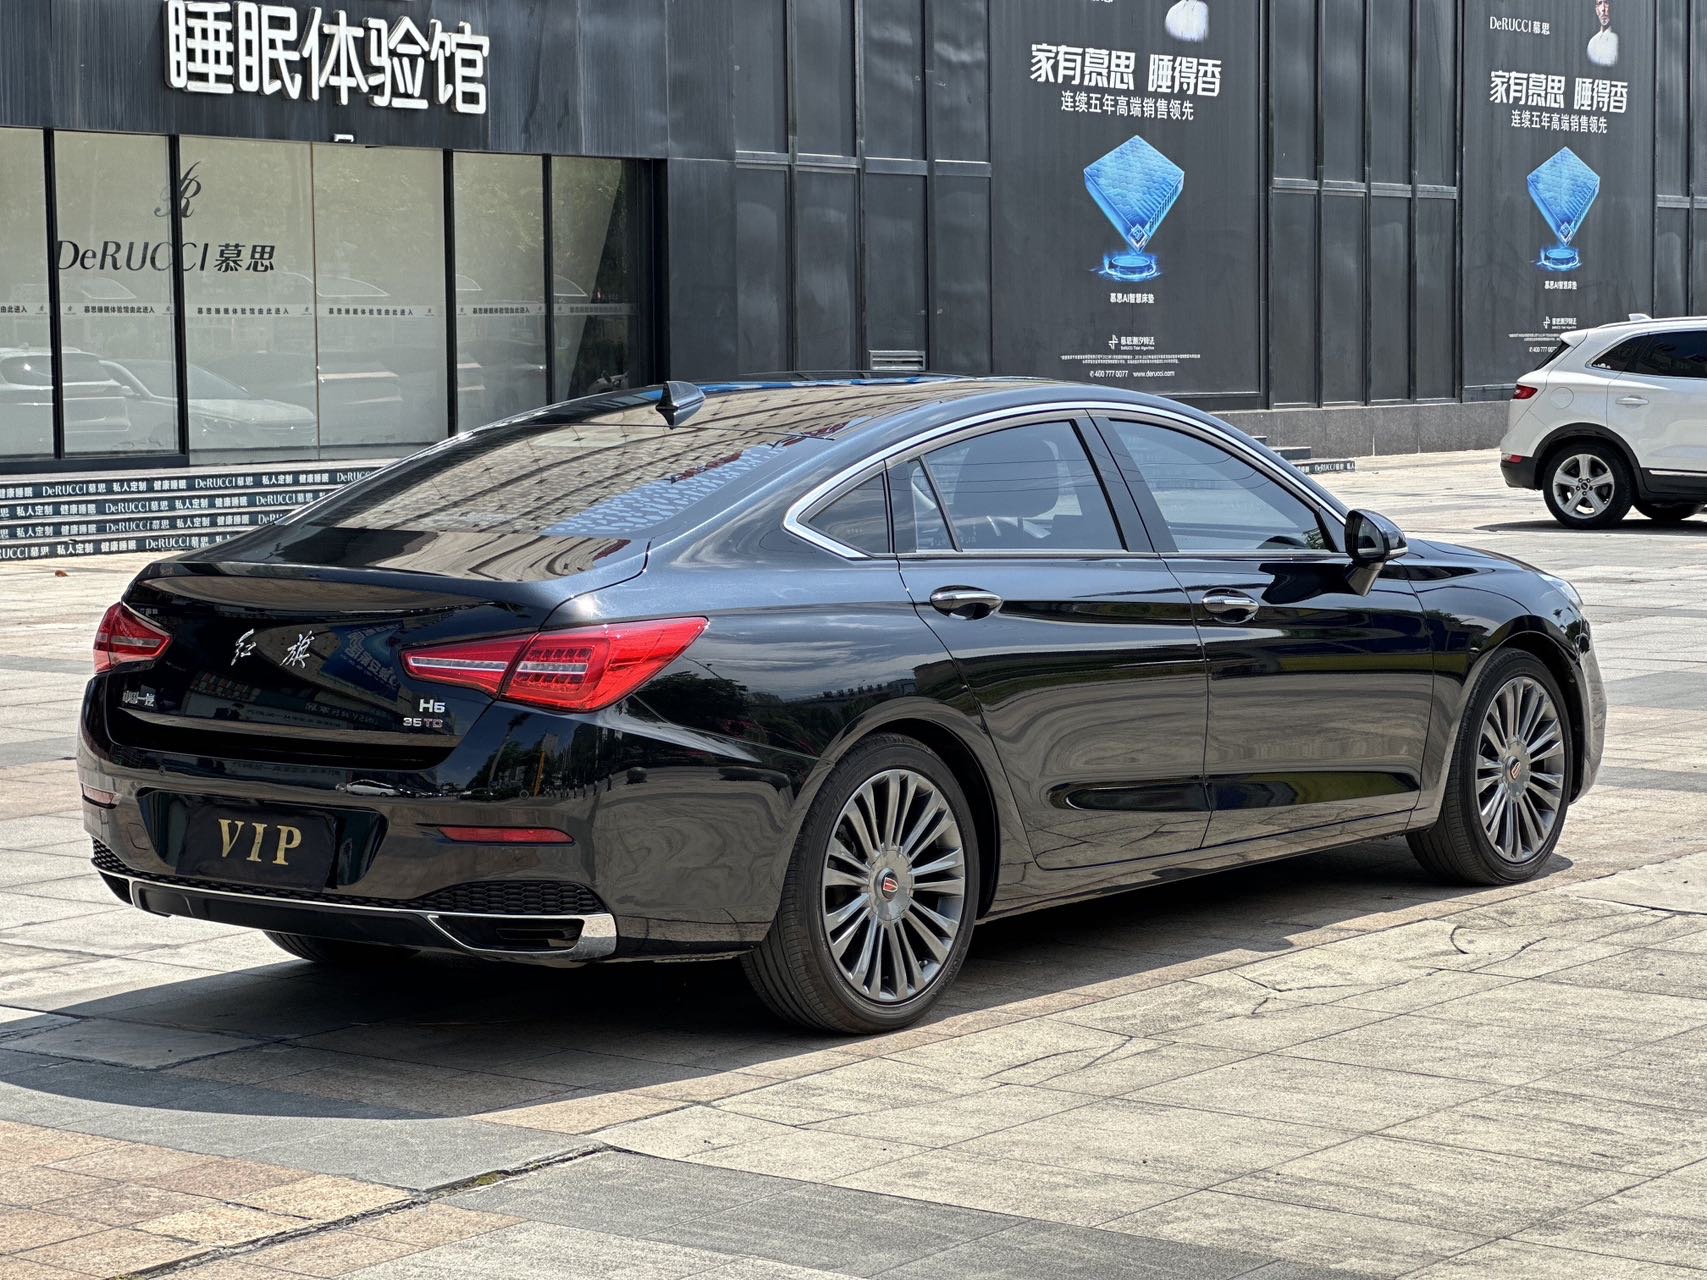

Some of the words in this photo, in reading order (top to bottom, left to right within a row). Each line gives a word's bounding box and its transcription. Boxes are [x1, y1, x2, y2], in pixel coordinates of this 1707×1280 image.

[1489, 16, 1532, 33] DeRUCCI
[1532, 20, 1550, 36] 慕思
[164, 0, 489, 114] 睡眠体验馆
[1029, 43, 1136, 91] 家有慕思
[1147, 53, 1222, 97] 睡得香
[1489, 70, 1566, 109] 家有慕思
[1573, 76, 1628, 114] 睡得香
[1060, 90, 1194, 121] 连续五年高端销售领先
[1511, 109, 1608, 134] 连续五年高端销售领先
[214, 243, 275, 273] 慕思
[42, 484, 87, 496] DeRUCCI
[113, 481, 147, 493] 私人定制
[195, 477, 236, 489] DeRUCCI
[262, 474, 293, 485] 私人定制
[17, 505, 53, 517] 私人定制
[105, 501, 149, 514] DeRUCCI
[175, 498, 208, 509] 私人定制
[256, 493, 296, 505] DeRUCCI
[17, 526, 53, 538] 私人定制
[106, 521, 150, 533] DeRUCCI
[176, 516, 210, 528] 私人定制
[57, 543, 94, 555] 私人定制
[145, 537, 190, 549] DeRUCCI
[218, 818, 302, 866] VIP
